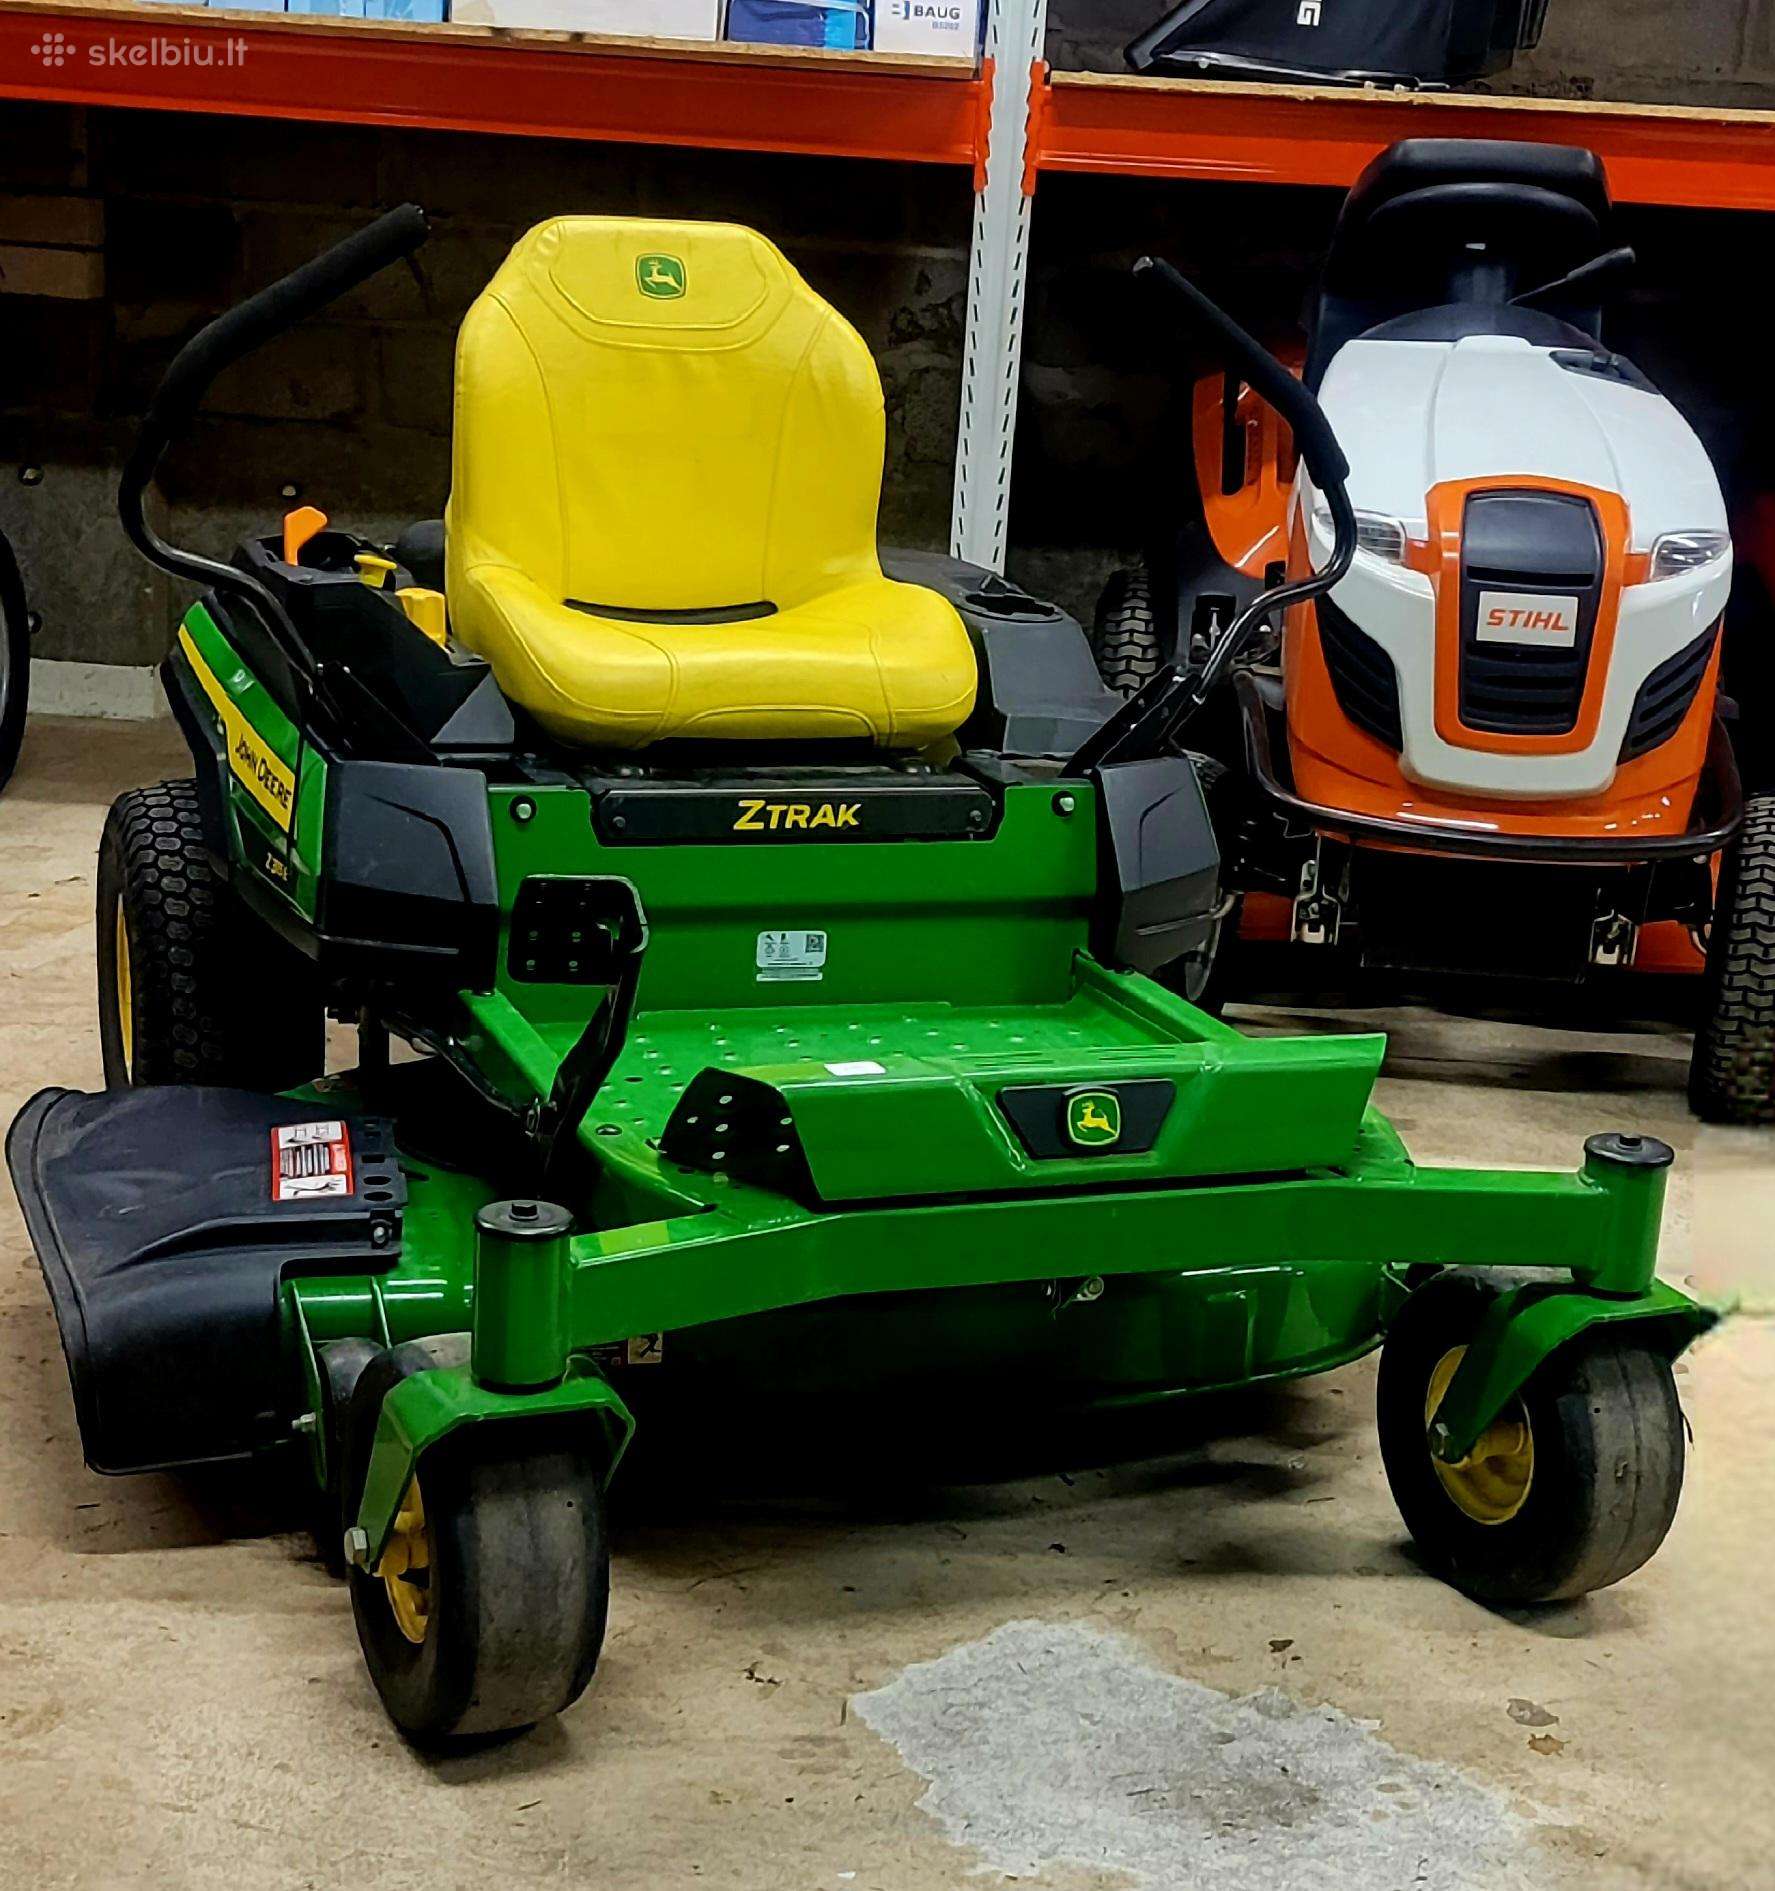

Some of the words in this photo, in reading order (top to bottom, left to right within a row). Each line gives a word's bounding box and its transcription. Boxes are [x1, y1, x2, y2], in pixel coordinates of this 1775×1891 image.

[913, 5, 961, 20] BAUG
[1486, 608, 1569, 631] STIHL
[235, 733, 258, 774] JOHN
[257, 758, 292, 810] DEERE
[733, 799, 862, 830] ZTRAK
